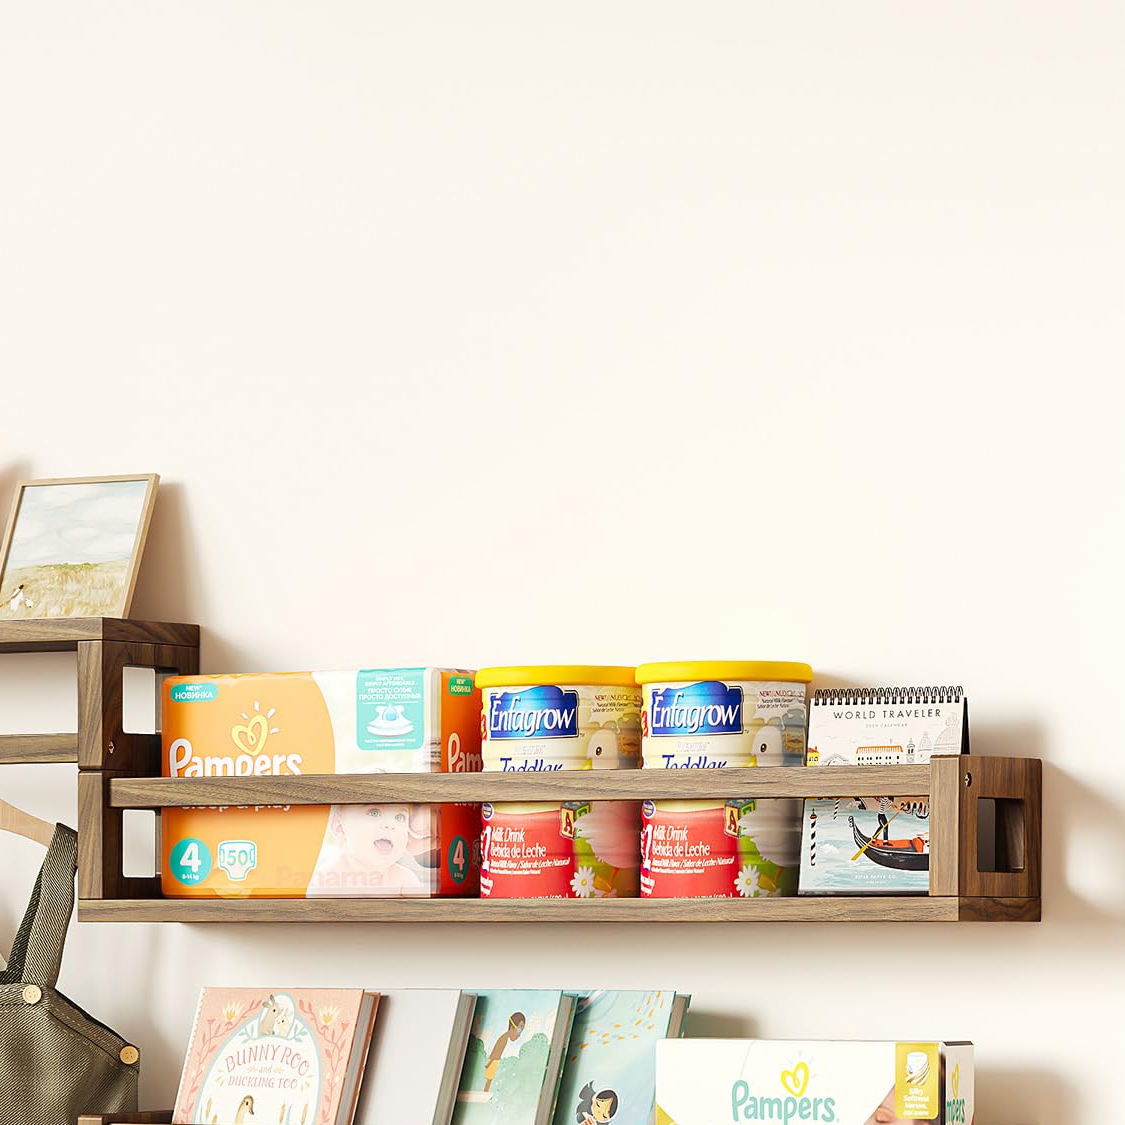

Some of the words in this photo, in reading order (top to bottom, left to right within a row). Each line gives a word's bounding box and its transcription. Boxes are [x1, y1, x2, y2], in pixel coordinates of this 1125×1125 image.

[175, 692, 213, 700] НОВИНКА
[491, 697, 575, 737] Enfagrow
[652, 691, 740, 733] Enfagrow
[833, 710, 876, 720] WORLD
[883, 709, 941, 719] TRAVELER
[505, 827, 525, 842] Drink
[666, 825, 688, 841] Drink
[453, 839, 465, 871] 4
[511, 845, 521, 858] de
[522, 842, 546, 858] Leche
[673, 843, 683, 857] de
[685, 841, 710, 857] Leche
[180, 842, 202, 873] 4
[227, 849, 248, 866] 50
[225, 1044, 281, 1073] BUNNY
[280, 1046, 310, 1076] ROO
[258, 1065, 272, 1073] and
[228, 1075, 275, 1089] DUCKLING
[278, 1078, 298, 1089] TOO
